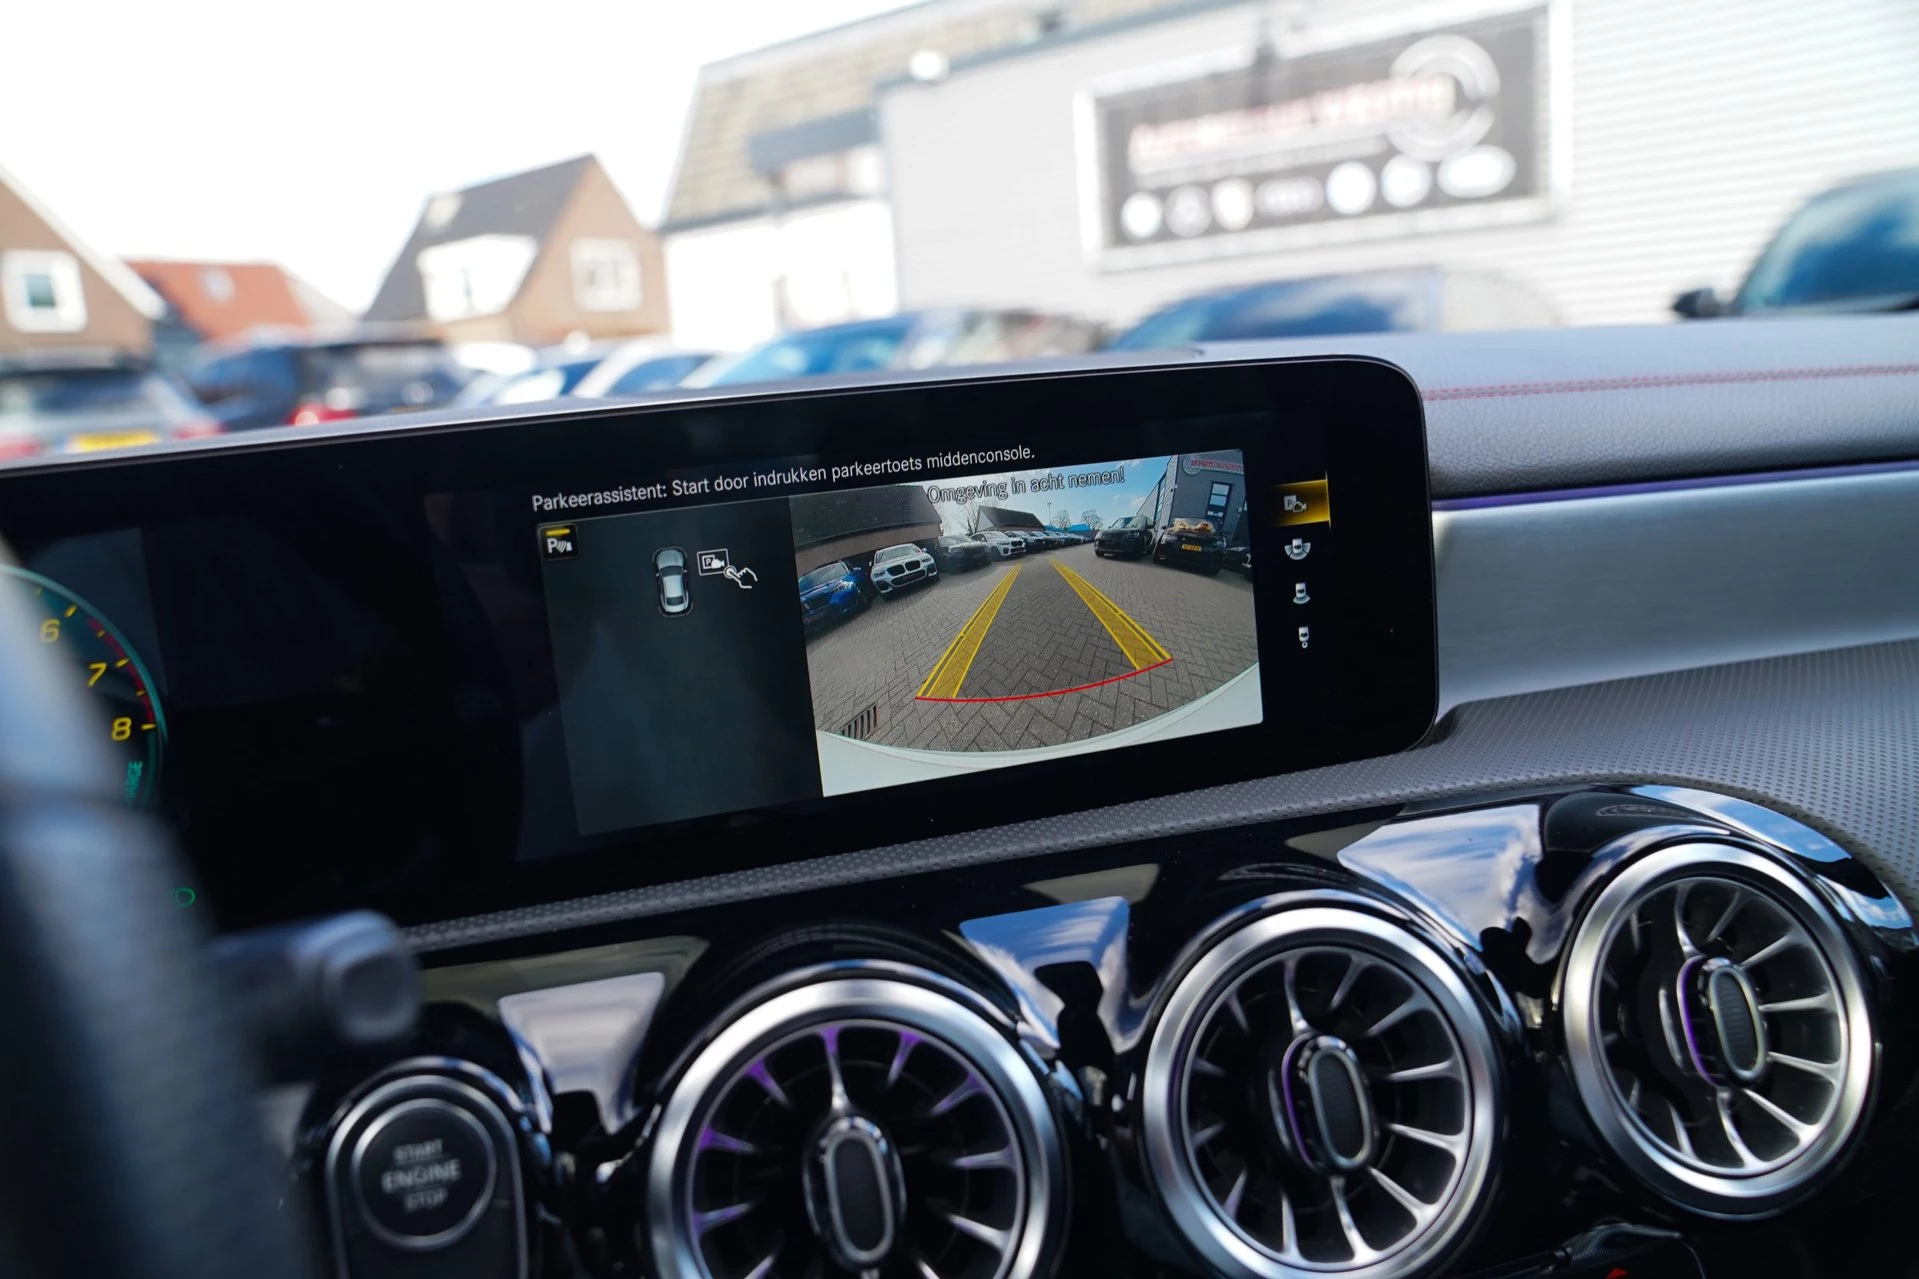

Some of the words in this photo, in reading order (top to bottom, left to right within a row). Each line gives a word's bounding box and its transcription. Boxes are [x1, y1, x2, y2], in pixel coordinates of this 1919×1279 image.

[532, 484, 667, 512] Parkeerassistent:
[672, 479, 709, 496] Start
[714, 474, 748, 492] door
[753, 466, 827, 486] indrukken
[831, 456, 922, 482] parkeertoets
[926, 445, 1036, 469] middenconsole.
[927, 480, 1008, 505] Omgeving
[1011, 477, 1027, 494] in
[1030, 473, 1065, 493] acht
[1068, 466, 1125, 489] nemen!
[41, 619, 60, 642] 6
[88, 663, 107, 686] 7
[111, 717, 132, 741] 8
[381, 1158, 462, 1193] ENGINE
